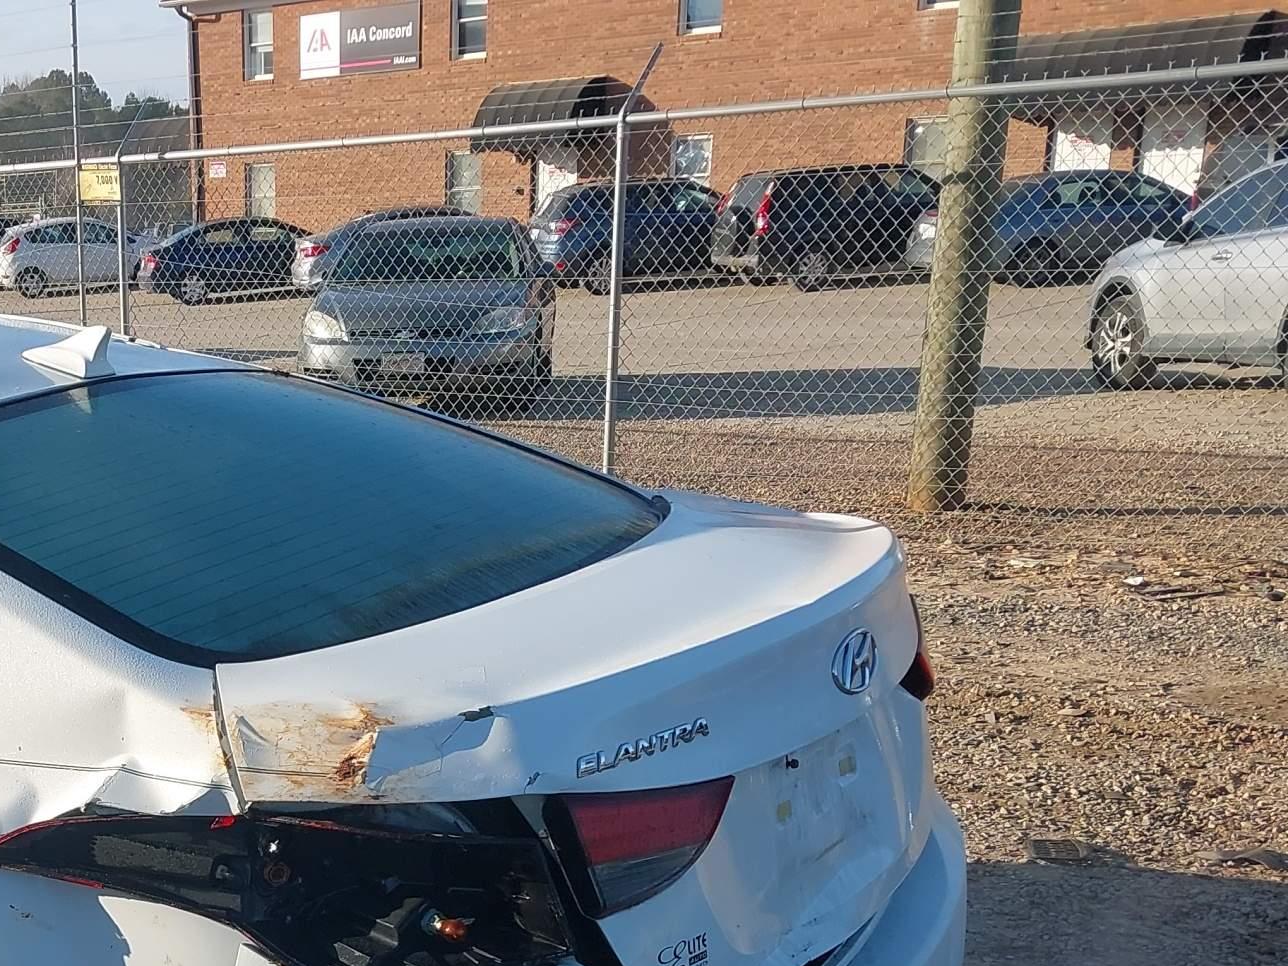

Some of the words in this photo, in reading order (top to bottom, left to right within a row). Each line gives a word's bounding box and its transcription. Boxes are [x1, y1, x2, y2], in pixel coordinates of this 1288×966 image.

[347, 27, 367, 44] IAA
[369, 22, 413, 42] Concord
[576, 716, 710, 779] ELANTRA
[690, 950, 707, 965] AUTO
